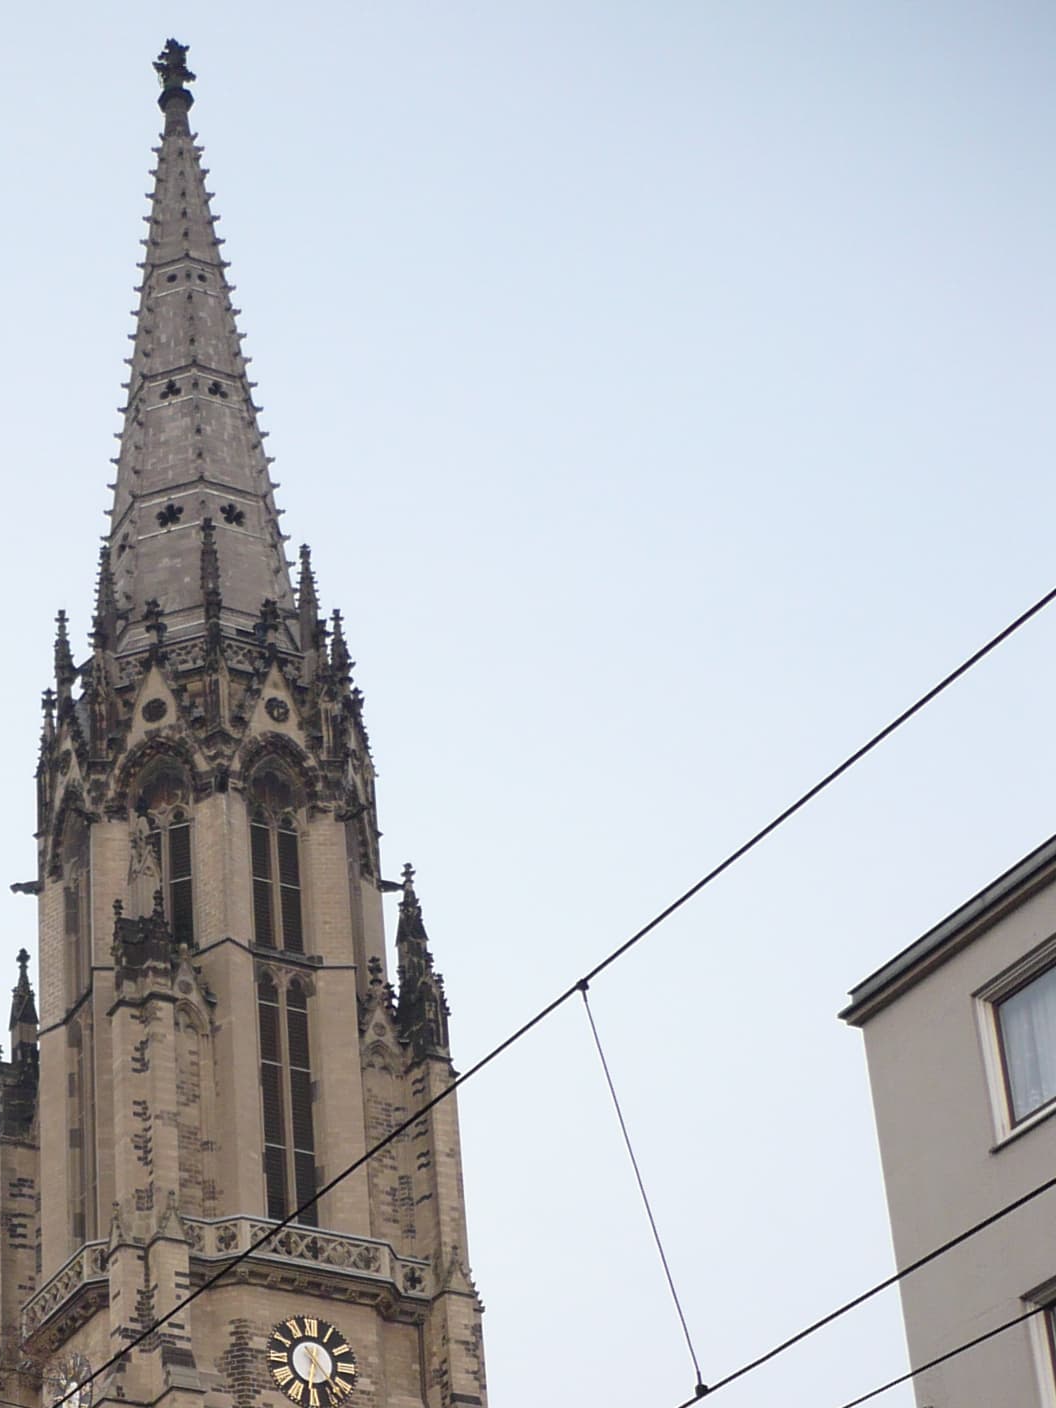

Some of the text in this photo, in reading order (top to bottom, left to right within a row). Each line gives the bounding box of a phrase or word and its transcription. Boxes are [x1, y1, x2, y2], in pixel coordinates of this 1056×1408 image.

[304, 1318, 318, 1338] XII
[332, 1344, 350, 1356] II
[337, 1362, 356, 1375] III
